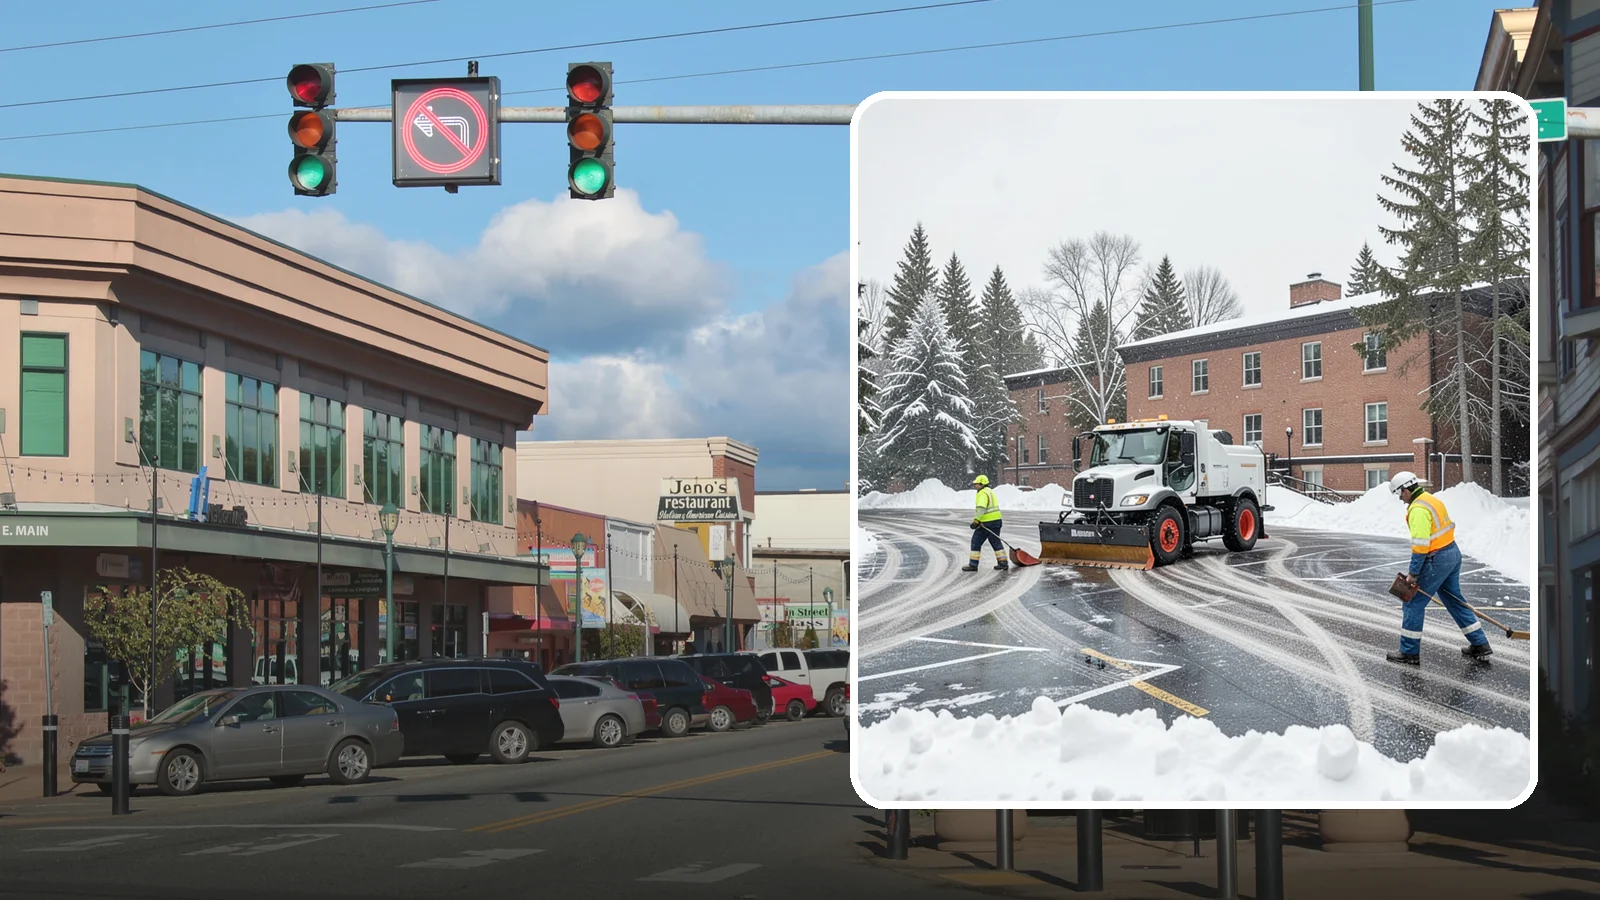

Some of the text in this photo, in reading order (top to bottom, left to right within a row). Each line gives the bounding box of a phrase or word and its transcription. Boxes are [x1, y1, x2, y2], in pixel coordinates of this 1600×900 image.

[670, 480, 727, 494] Jeno's
[665, 496, 731, 509] restaurant
[658, 509, 681, 519] Italian
[685, 509, 714, 519] American
[714, 508, 737, 519] Cuisine
[2, 525, 49, 536] E. MAIN
[797, 608, 828, 616] Street
